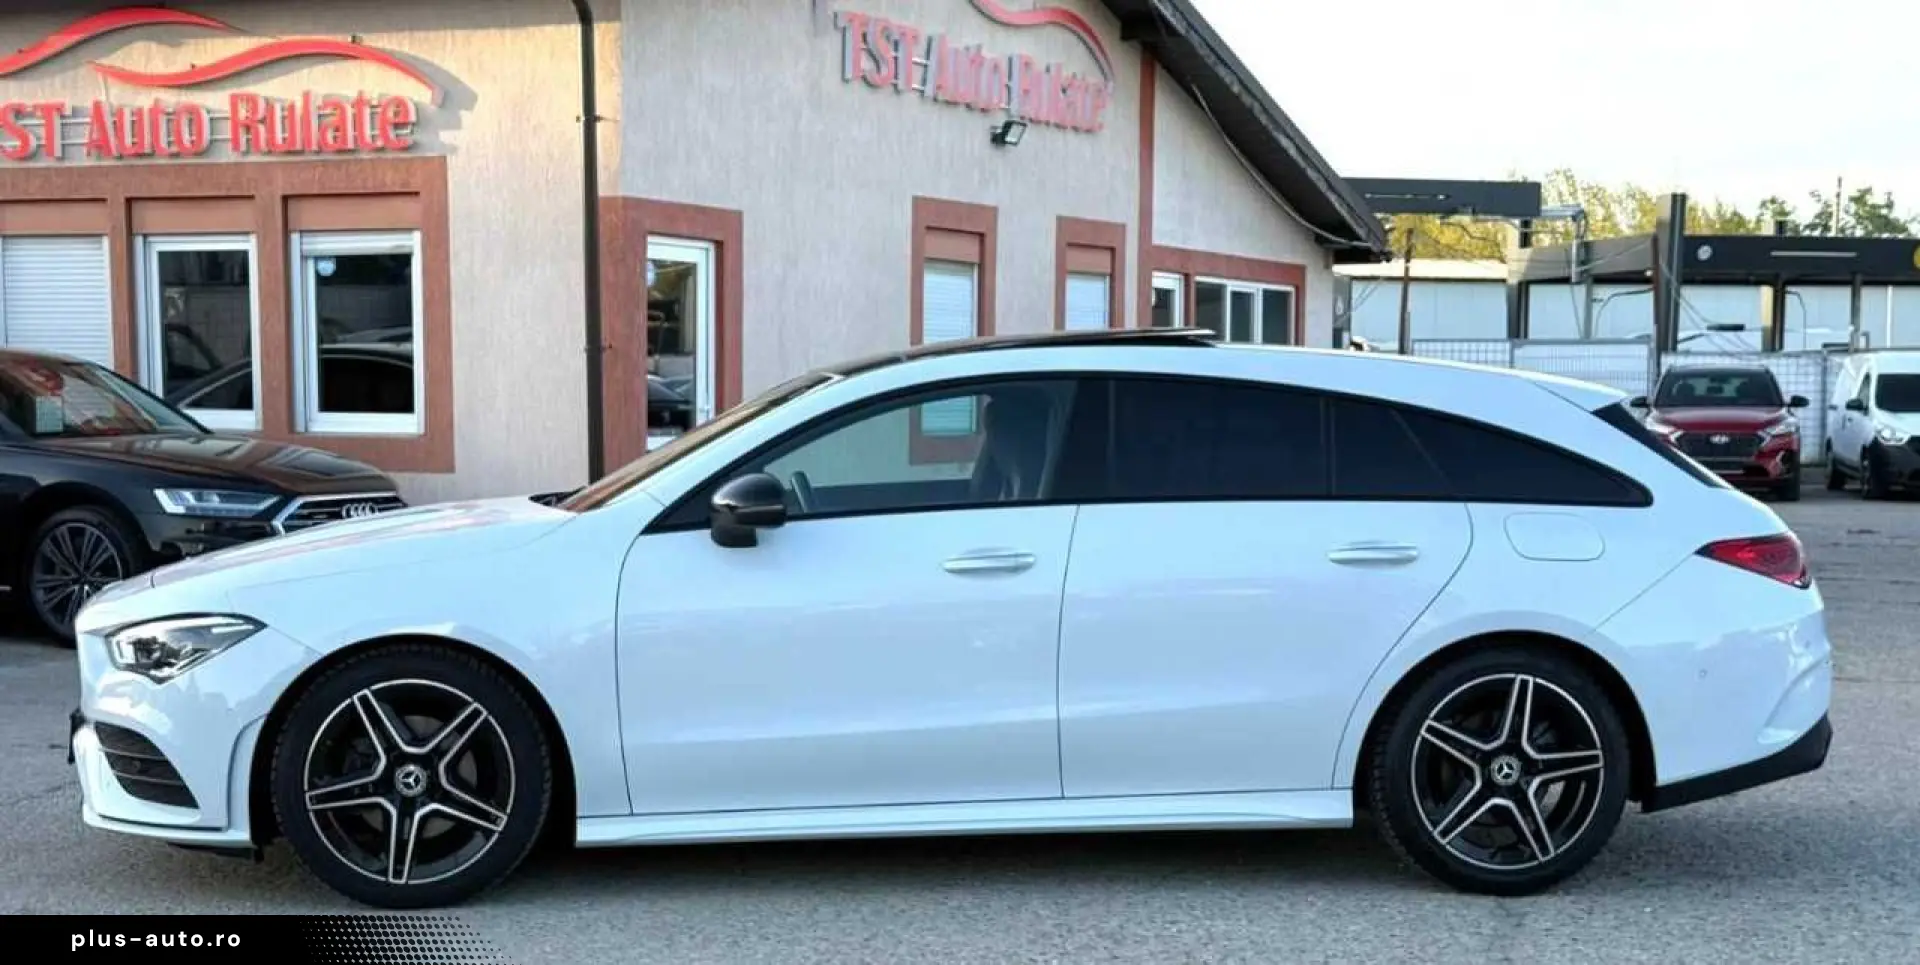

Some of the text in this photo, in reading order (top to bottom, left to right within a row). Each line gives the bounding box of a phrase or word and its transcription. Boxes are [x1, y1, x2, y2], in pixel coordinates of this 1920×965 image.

[836, 11, 923, 93] TST
[925, 35, 1009, 113] Auto
[86, 98, 210, 157] Auto
[229, 90, 416, 153] Rulate
